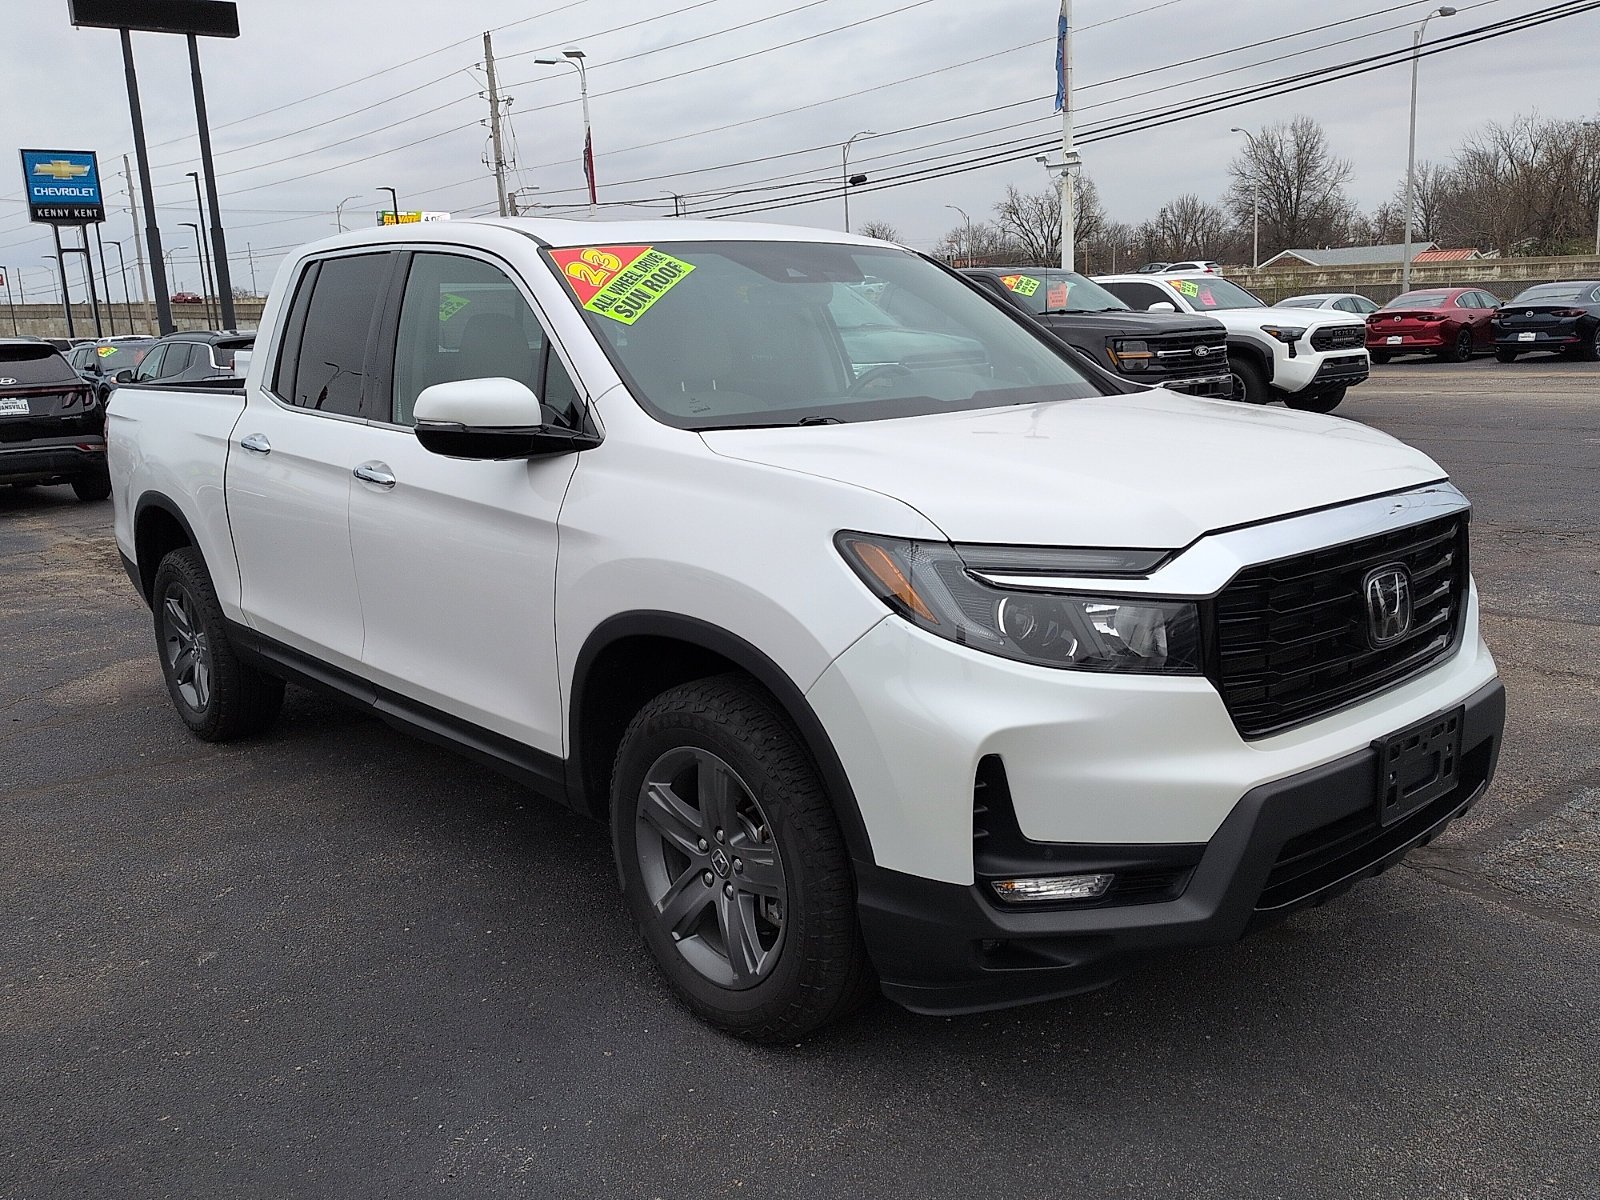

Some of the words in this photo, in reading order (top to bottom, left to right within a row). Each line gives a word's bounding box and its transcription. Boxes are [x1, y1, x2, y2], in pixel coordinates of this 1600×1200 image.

[34, 187, 95, 196] CHEVROLET
[37, 208, 70, 217] KENNY
[74, 209, 98, 217] KENT
[384, 215, 419, 223] ELVATE
[564, 248, 623, 287] 23
[592, 294, 619, 313] ALL
[611, 270, 643, 296] WHEEL
[634, 252, 666, 275] DRIVE
[614, 287, 654, 319] SUN
[642, 261, 684, 293] ROOF
